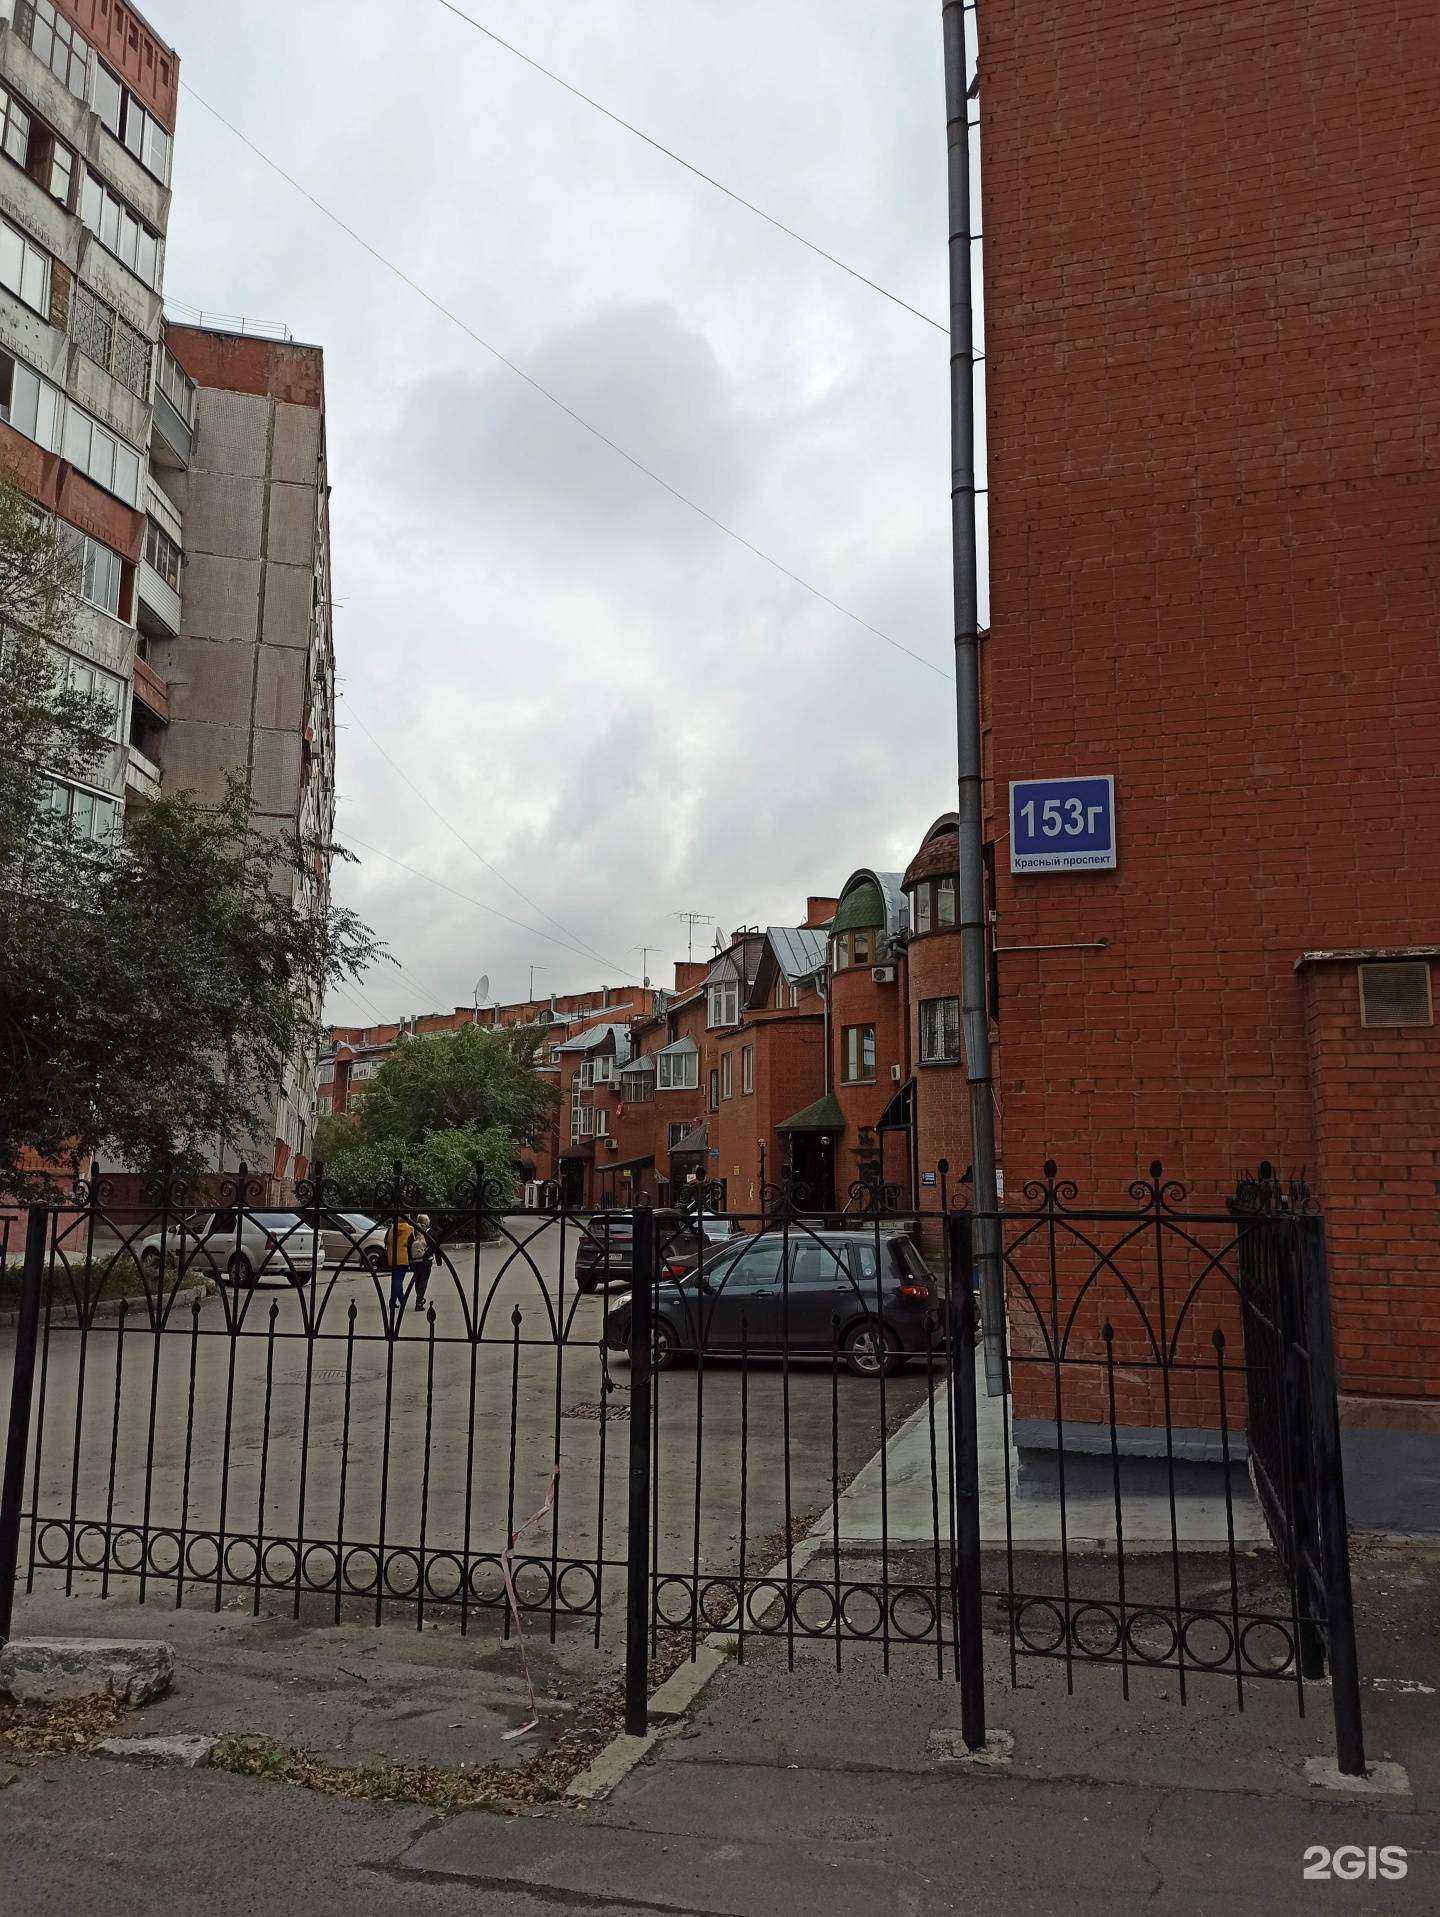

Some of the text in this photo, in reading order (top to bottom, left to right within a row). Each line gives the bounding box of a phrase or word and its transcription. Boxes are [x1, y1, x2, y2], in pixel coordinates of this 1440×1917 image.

[1020, 797, 1103, 837] 153г
[1015, 855, 1111, 869] Красный проспект
